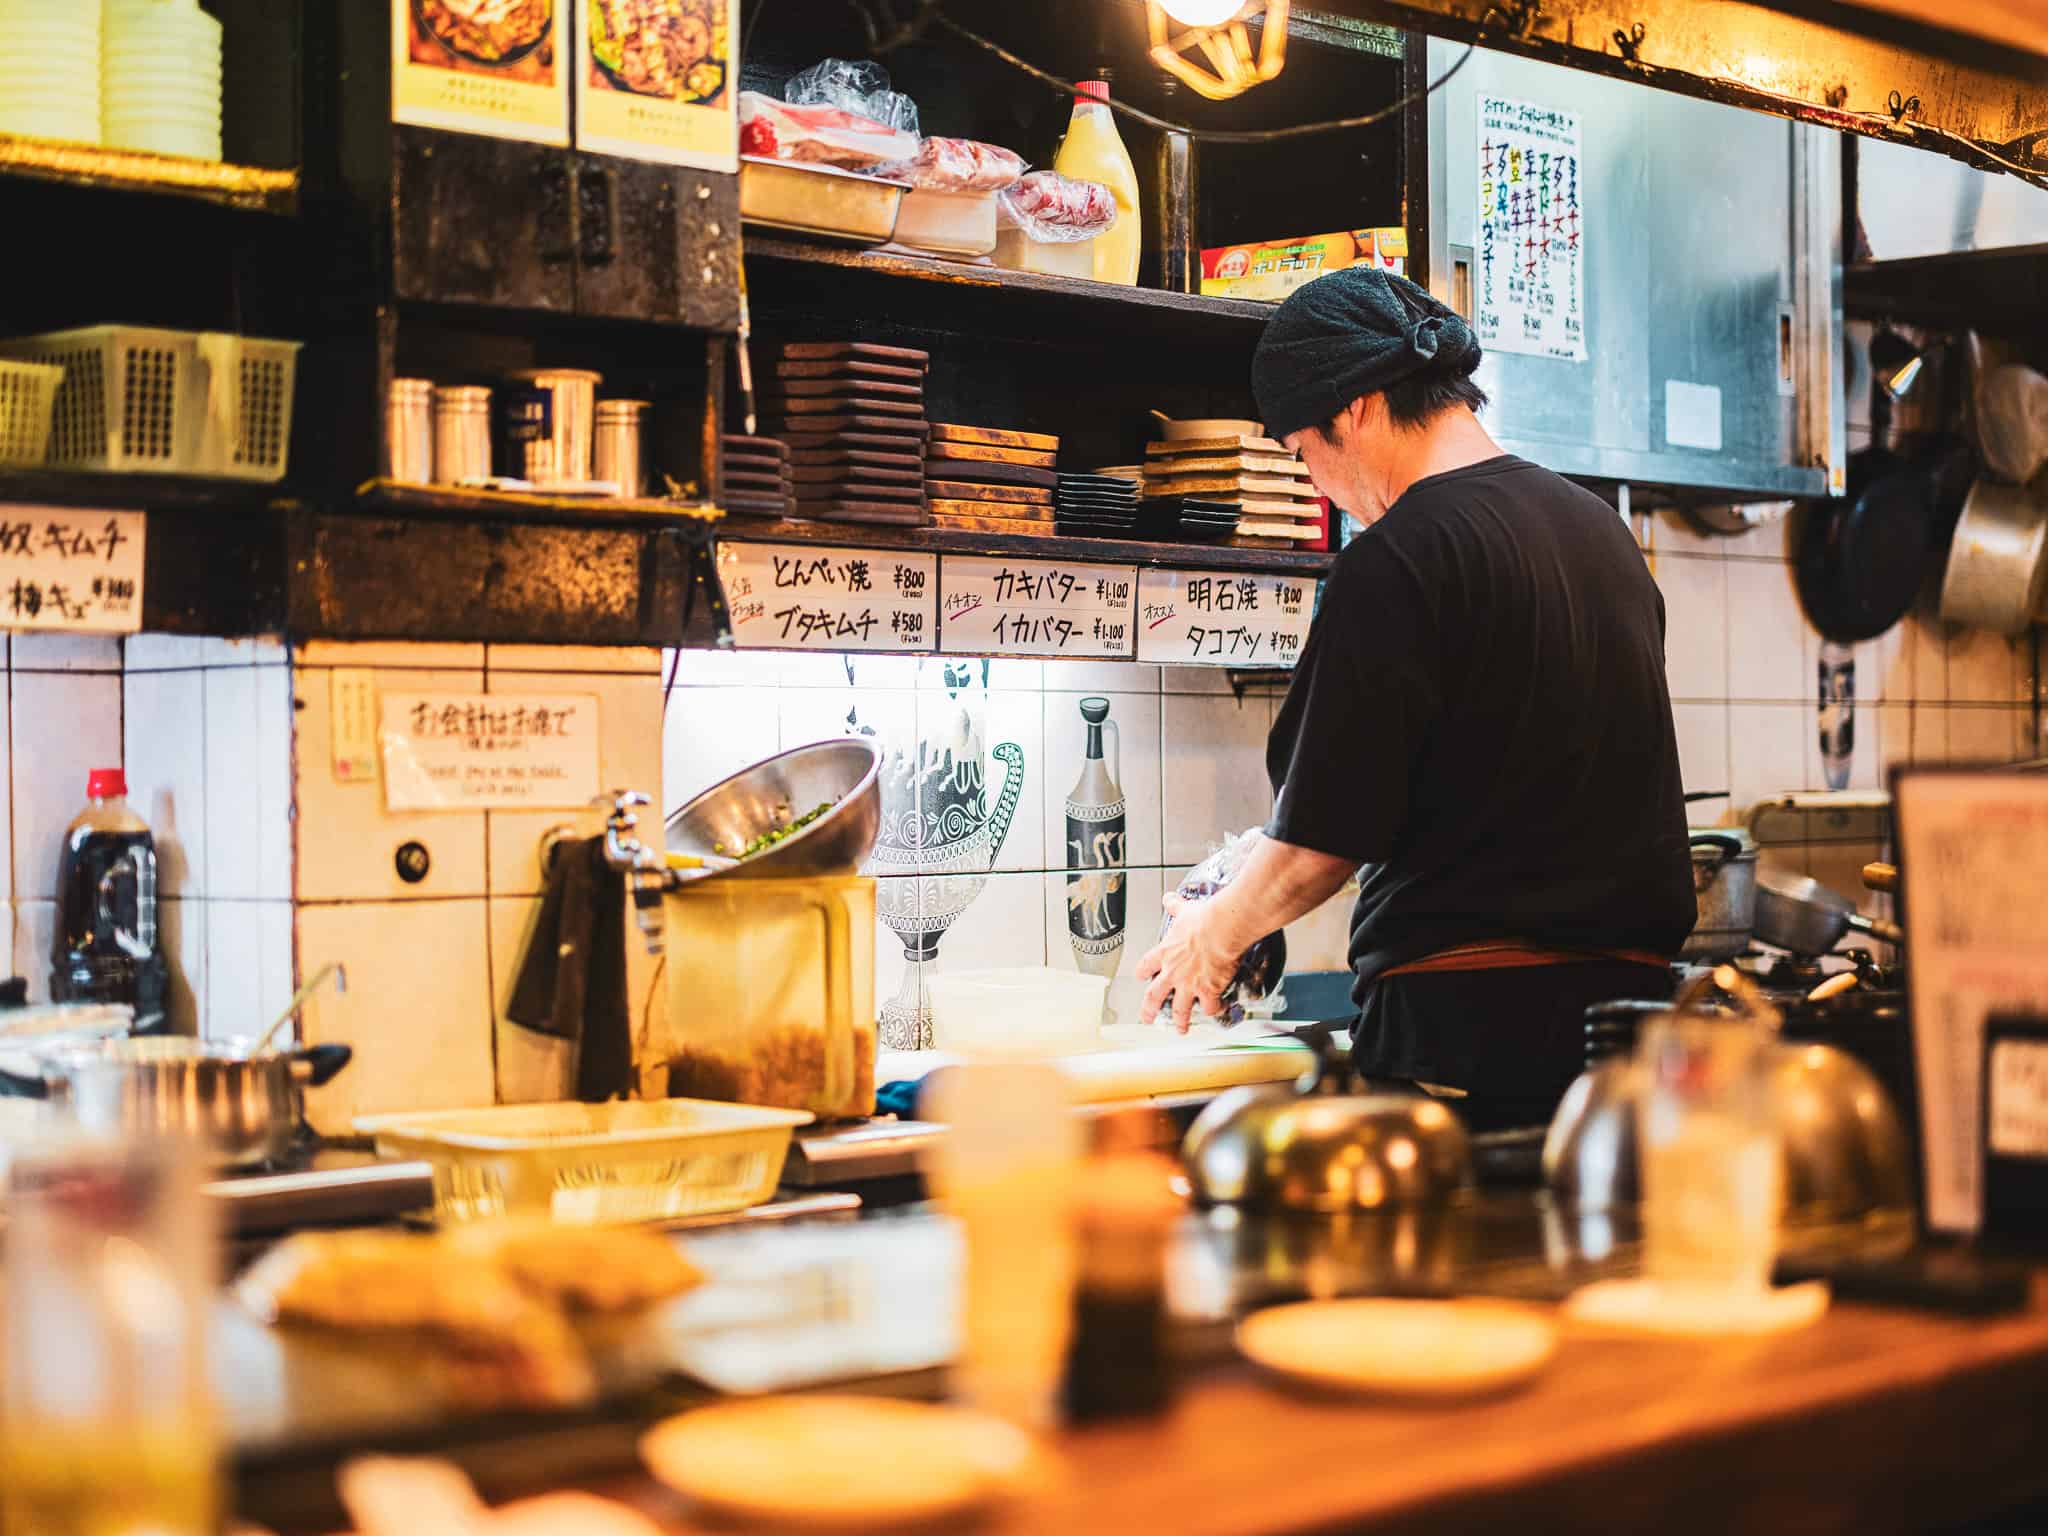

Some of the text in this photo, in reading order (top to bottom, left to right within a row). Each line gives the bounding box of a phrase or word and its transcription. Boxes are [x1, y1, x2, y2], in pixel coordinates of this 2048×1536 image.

[773, 555, 925, 592] とんぺい焼 ¥800
[993, 567, 1087, 603] カキバター
[944, 592, 982, 610] イチオシ
[1143, 603, 1175, 620] オススメ
[1187, 577, 1303, 612] 明石焼 ¥800
[774, 605, 923, 642] ブタキムチ ¥580
[992, 613, 1084, 647] イカバター
[1186, 625, 1299, 659] タコブツ ¥750
